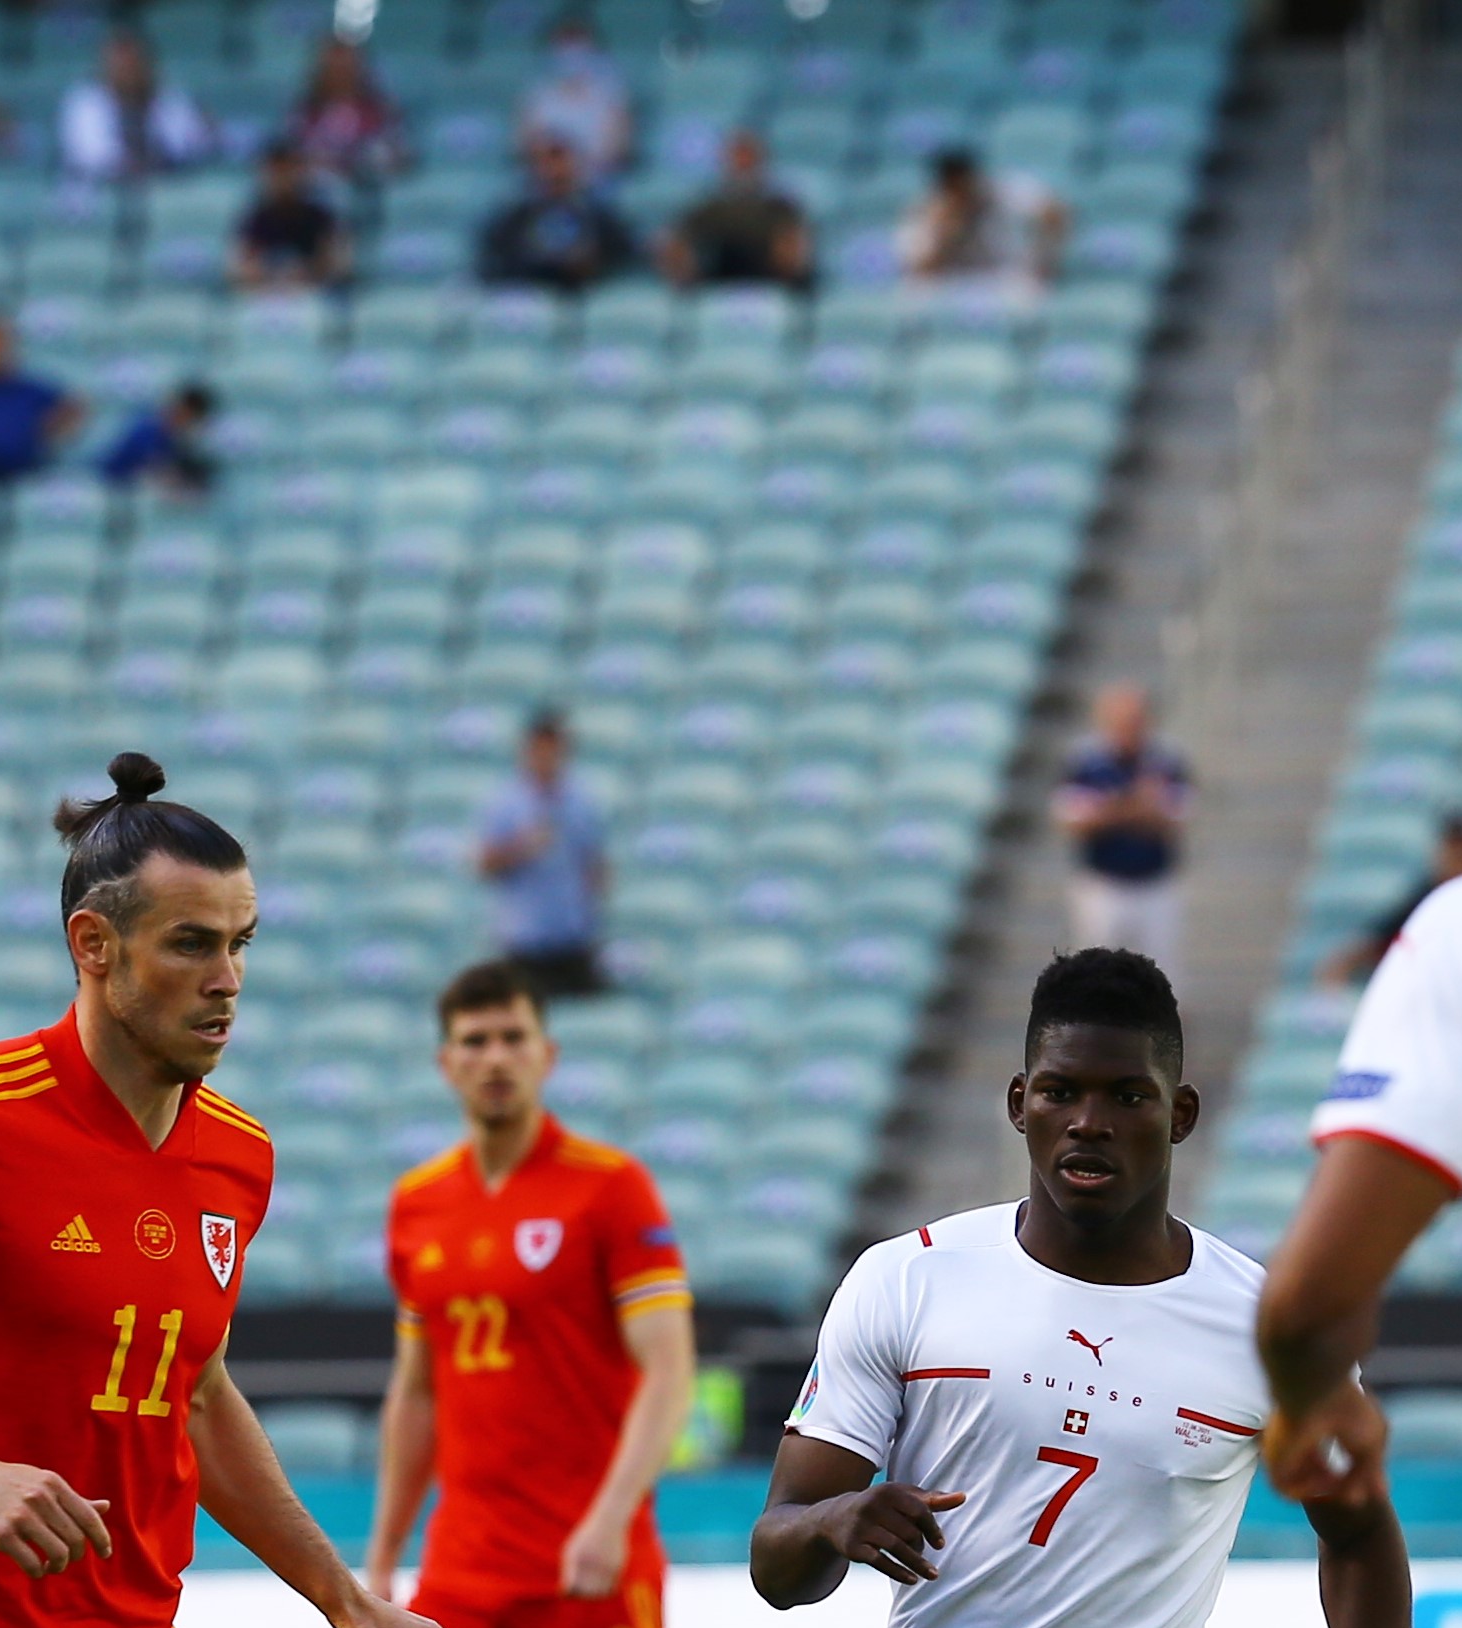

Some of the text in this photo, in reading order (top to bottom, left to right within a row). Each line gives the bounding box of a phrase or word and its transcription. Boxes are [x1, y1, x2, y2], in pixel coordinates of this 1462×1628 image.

[50, 1239, 101, 1253] adidas
[90, 1303, 184, 1418] 11
[447, 1294, 515, 1373] 22
[1022, 1372, 1143, 1407] suisse
[1027, 1445, 1100, 1548] 7
